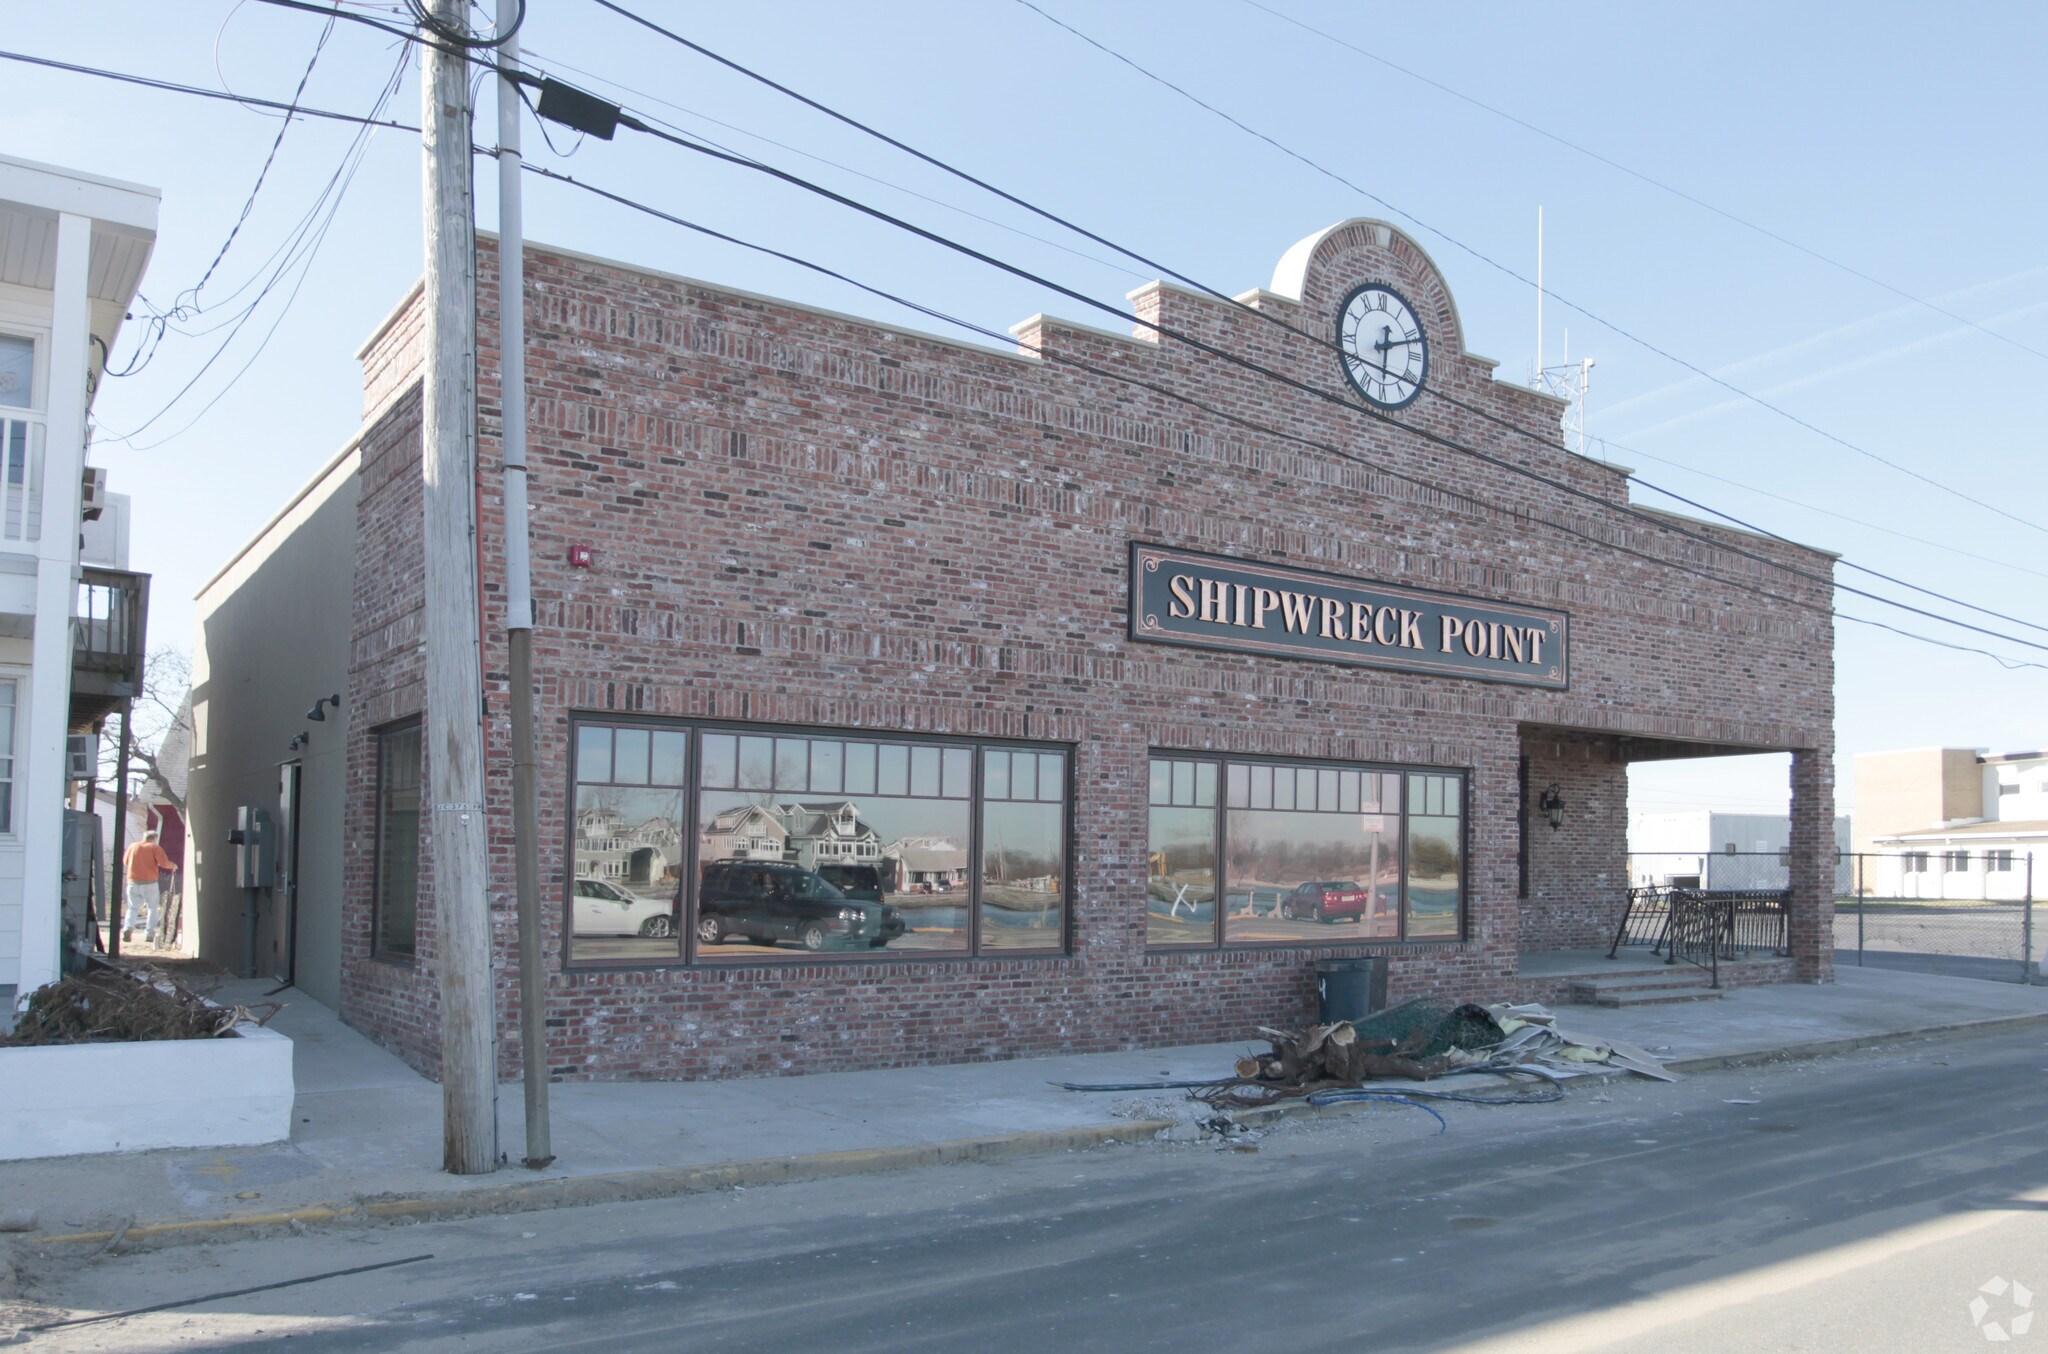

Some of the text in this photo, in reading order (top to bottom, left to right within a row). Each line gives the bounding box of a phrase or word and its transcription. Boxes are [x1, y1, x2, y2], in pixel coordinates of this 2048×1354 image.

[1377, 293, 1387, 312] XII
[1347, 308, 1360, 324] X
[1396, 307, 1403, 320] I
[1405, 328, 1417, 337] II
[1409, 351, 1421, 362] III
[1397, 382, 1406, 399] V
[1169, 574, 1546, 665] SHIPWRECK POINT
[1318, 977, 1326, 1000] 4
